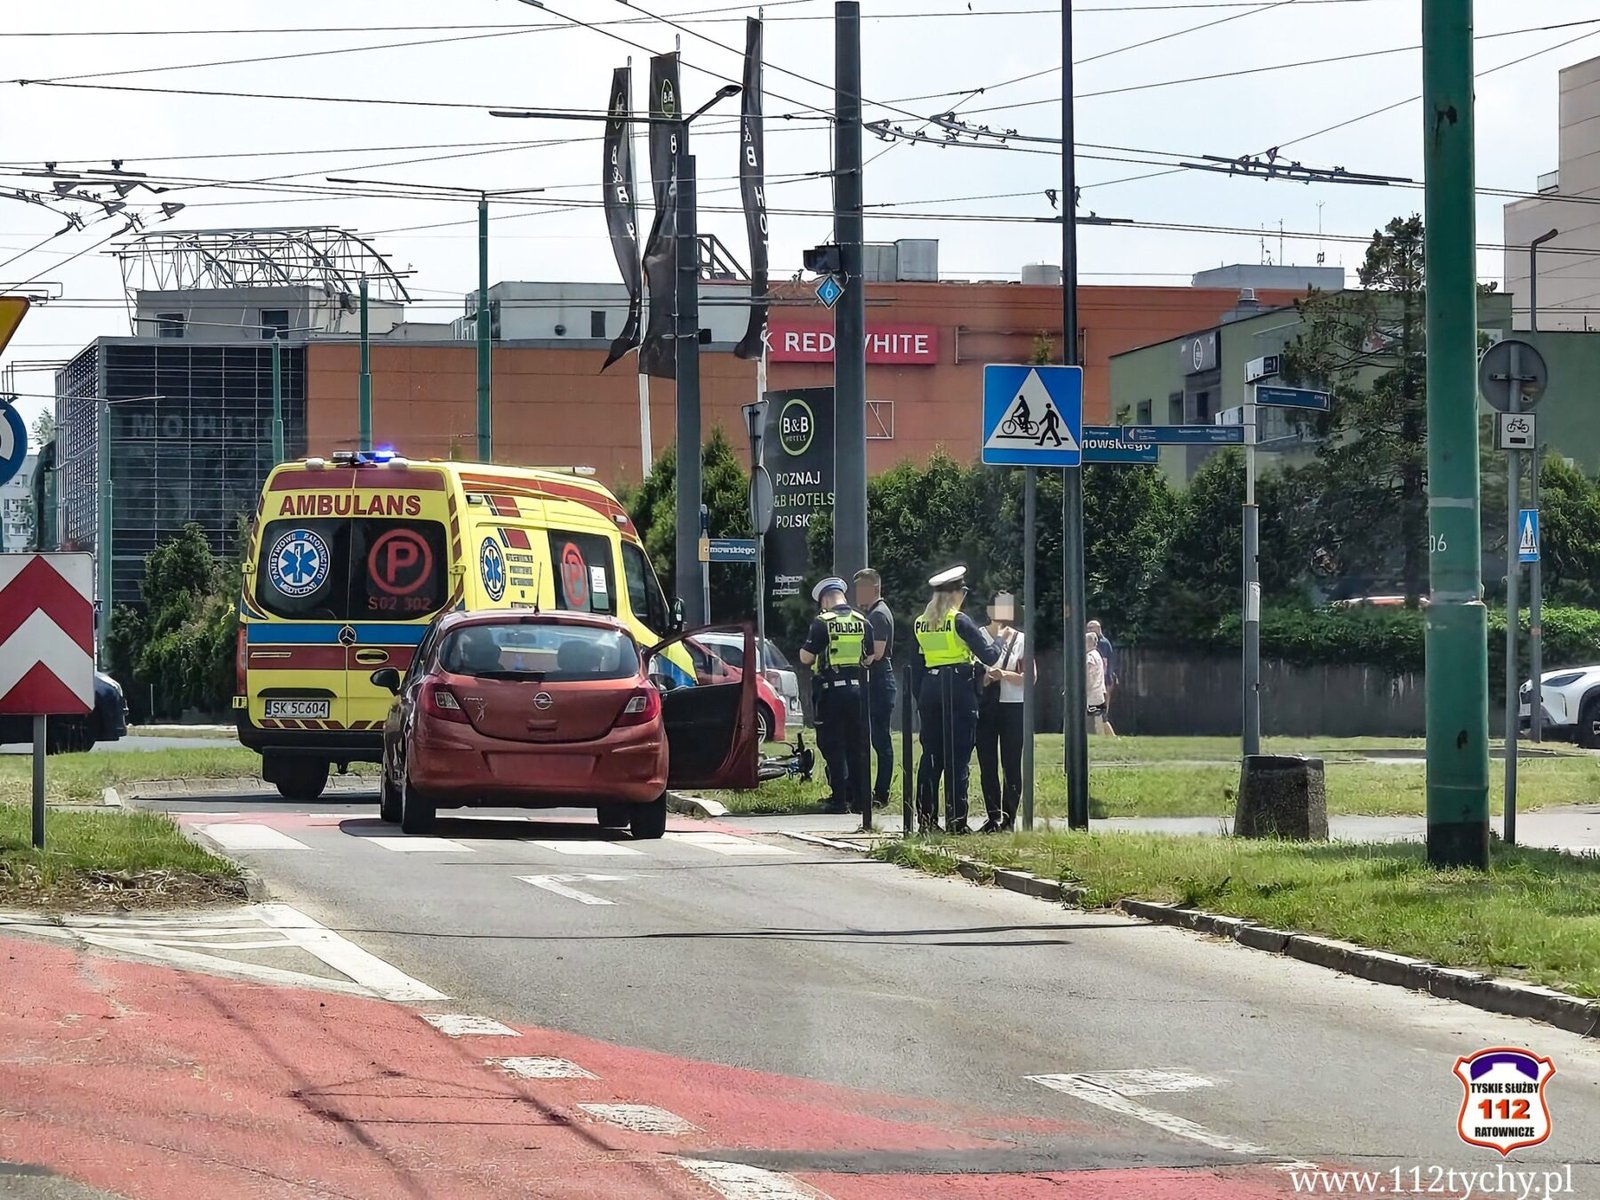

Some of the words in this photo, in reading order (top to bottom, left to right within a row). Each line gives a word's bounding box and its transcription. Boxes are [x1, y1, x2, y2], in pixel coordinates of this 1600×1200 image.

[826, 282, 834, 299] 6
[785, 332, 836, 352] RED
[783, 416, 809, 434] B&B
[776, 471, 821, 486] POZNAJ
[279, 494, 421, 516] AMBULANS
[773, 494, 787, 507] &B
[789, 492, 835, 507] HOTELS
[776, 514, 811, 528] POLSK
[387, 541, 418, 583] P
[829, 621, 864, 633] POLICJA
[273, 702, 287, 714] SK
[291, 702, 326, 714] 5C604
